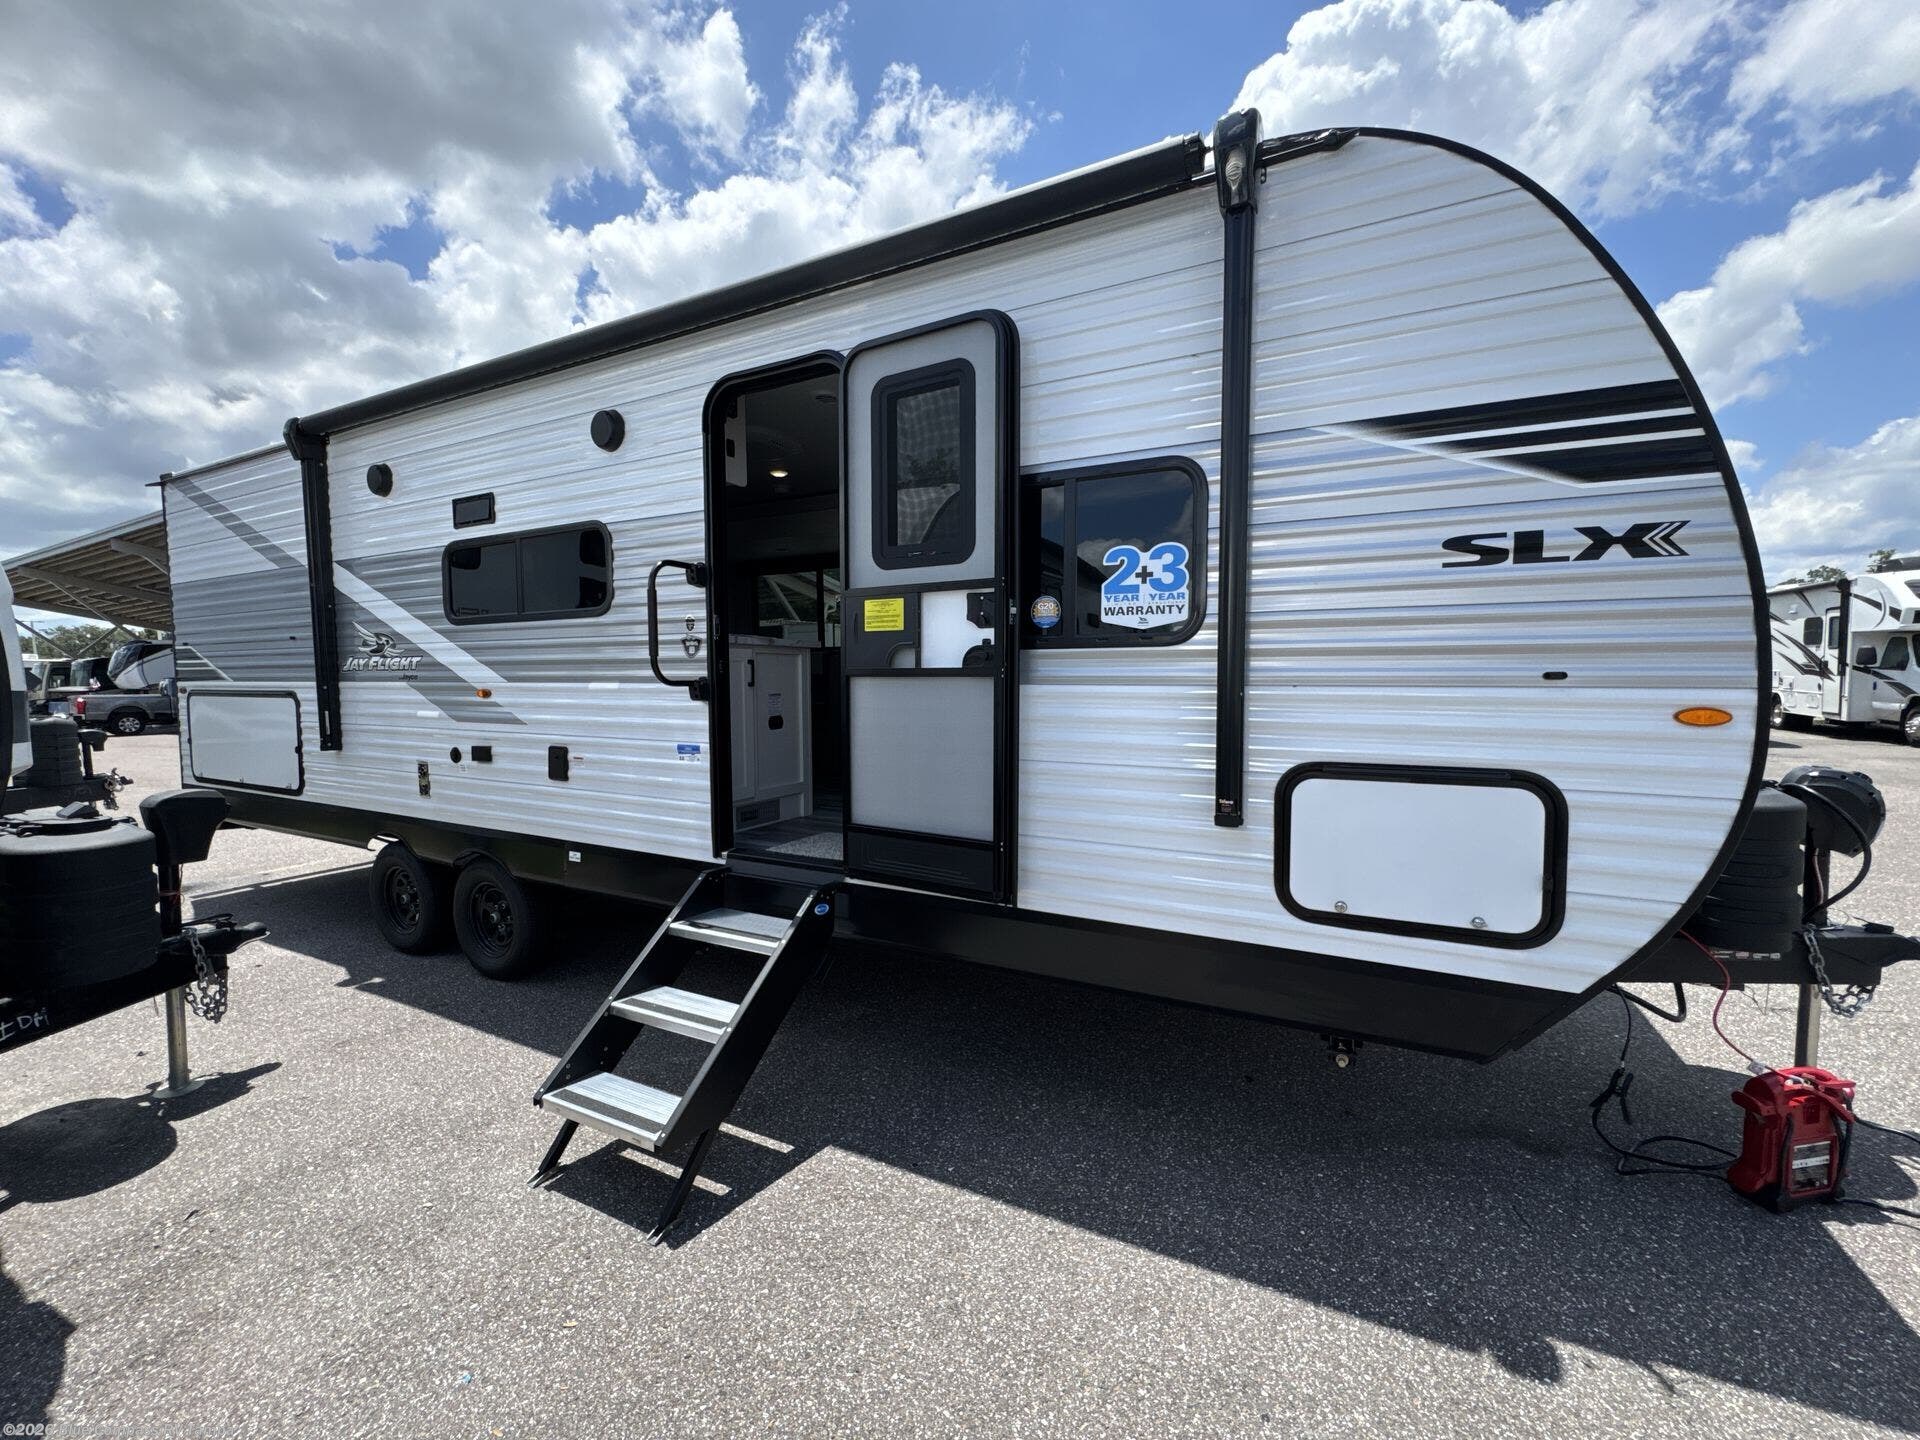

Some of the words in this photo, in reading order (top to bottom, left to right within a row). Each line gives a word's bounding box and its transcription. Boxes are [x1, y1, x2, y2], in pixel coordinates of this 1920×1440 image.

[1441, 519, 1691, 569] SLX
[1105, 594, 1139, 603] YEAR
[1149, 592, 1185, 601] YEAR
[1104, 605, 1185, 616] WARRANTY
[342, 655, 369, 672] JAY
[369, 655, 423, 672] FLIGHT
